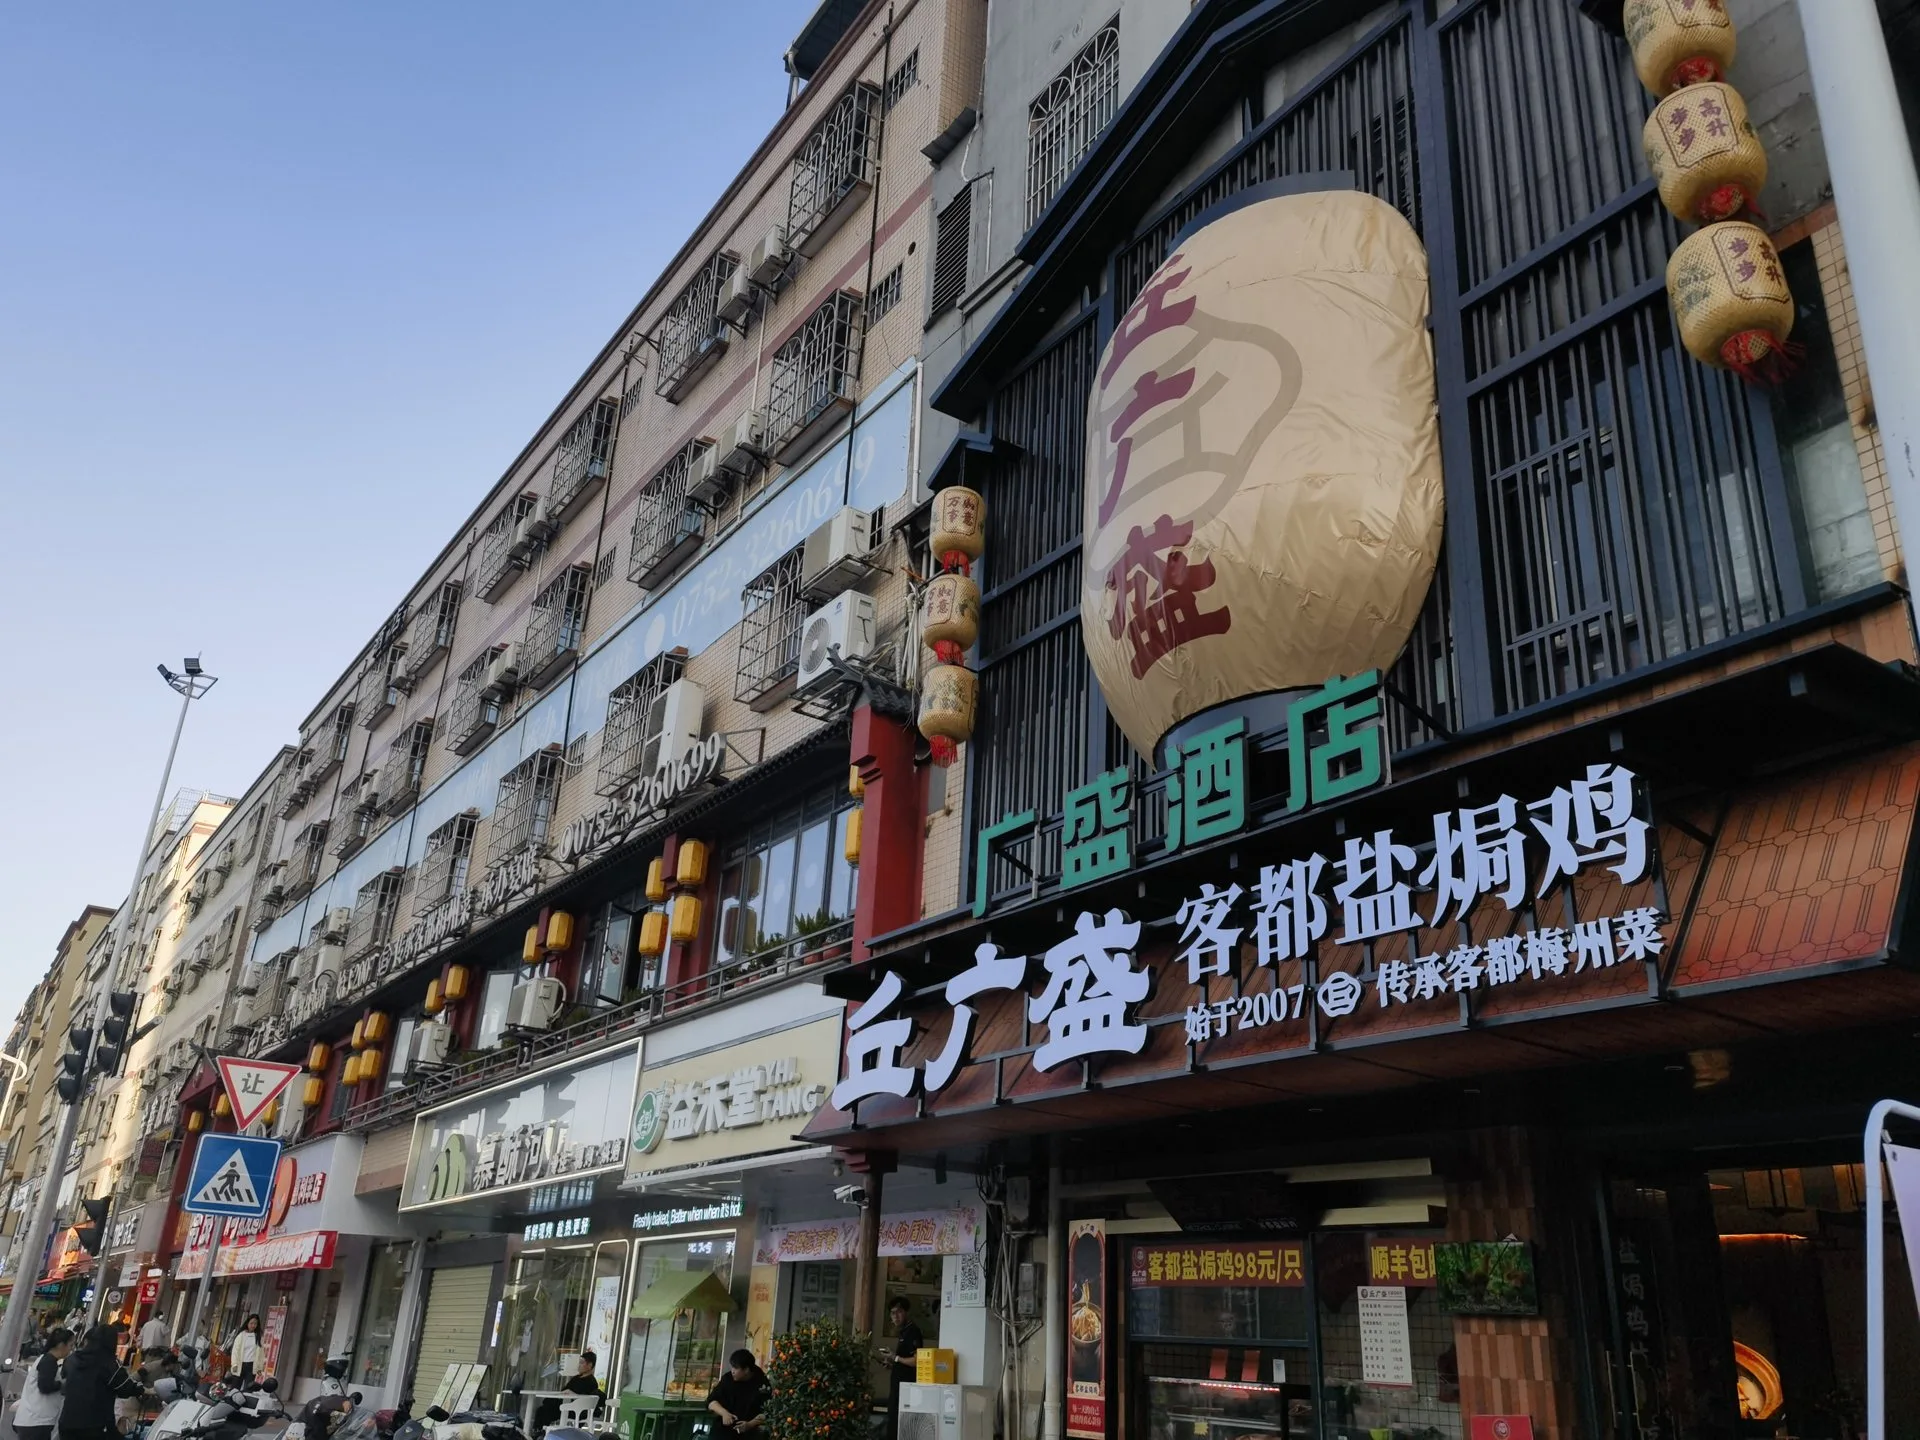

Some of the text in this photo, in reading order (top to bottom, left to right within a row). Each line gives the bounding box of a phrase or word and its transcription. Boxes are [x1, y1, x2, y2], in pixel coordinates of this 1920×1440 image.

[573, 731, 721, 855] 0752-3260699
[974, 667, 1385, 919] 广盛酒店
[1174, 762, 1655, 985] 客都盐焗鸡
[832, 907, 1151, 1112] 丘广盛
[1183, 906, 1666, 1044] 始于2007 传承客都梅州菜
[241, 1072, 266, 1097] 让
[665, 1064, 766, 1141] 益禾堂
[1147, 1249, 1303, 1283] 客都盐焗鸡98元/只
